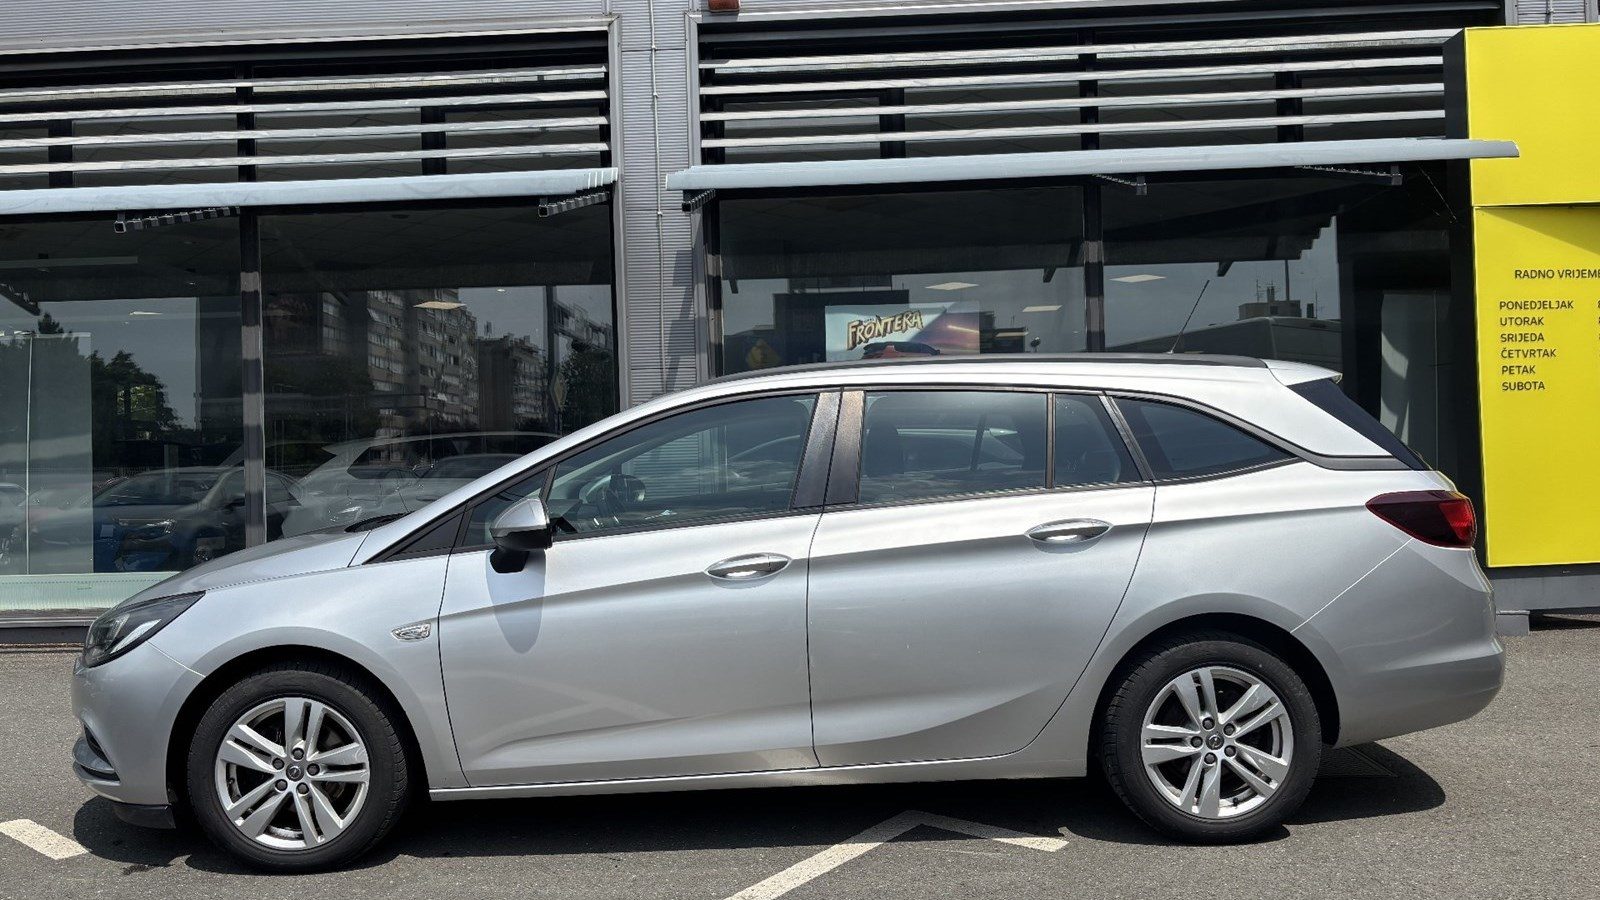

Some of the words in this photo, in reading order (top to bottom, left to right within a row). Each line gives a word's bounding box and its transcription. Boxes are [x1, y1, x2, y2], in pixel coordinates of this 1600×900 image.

[1514, 269, 1555, 279] RADNO
[1499, 300, 1574, 310] PONEDJELJAK
[1499, 316, 1545, 327] UTORAK
[847, 310, 924, 350] FRONTERA
[1500, 332, 1545, 343] SRIJEDA
[1500, 347, 1557, 359] ČETVRTAK
[1501, 365, 1536, 375] PETAK
[1501, 381, 1546, 391] SUBOTA
